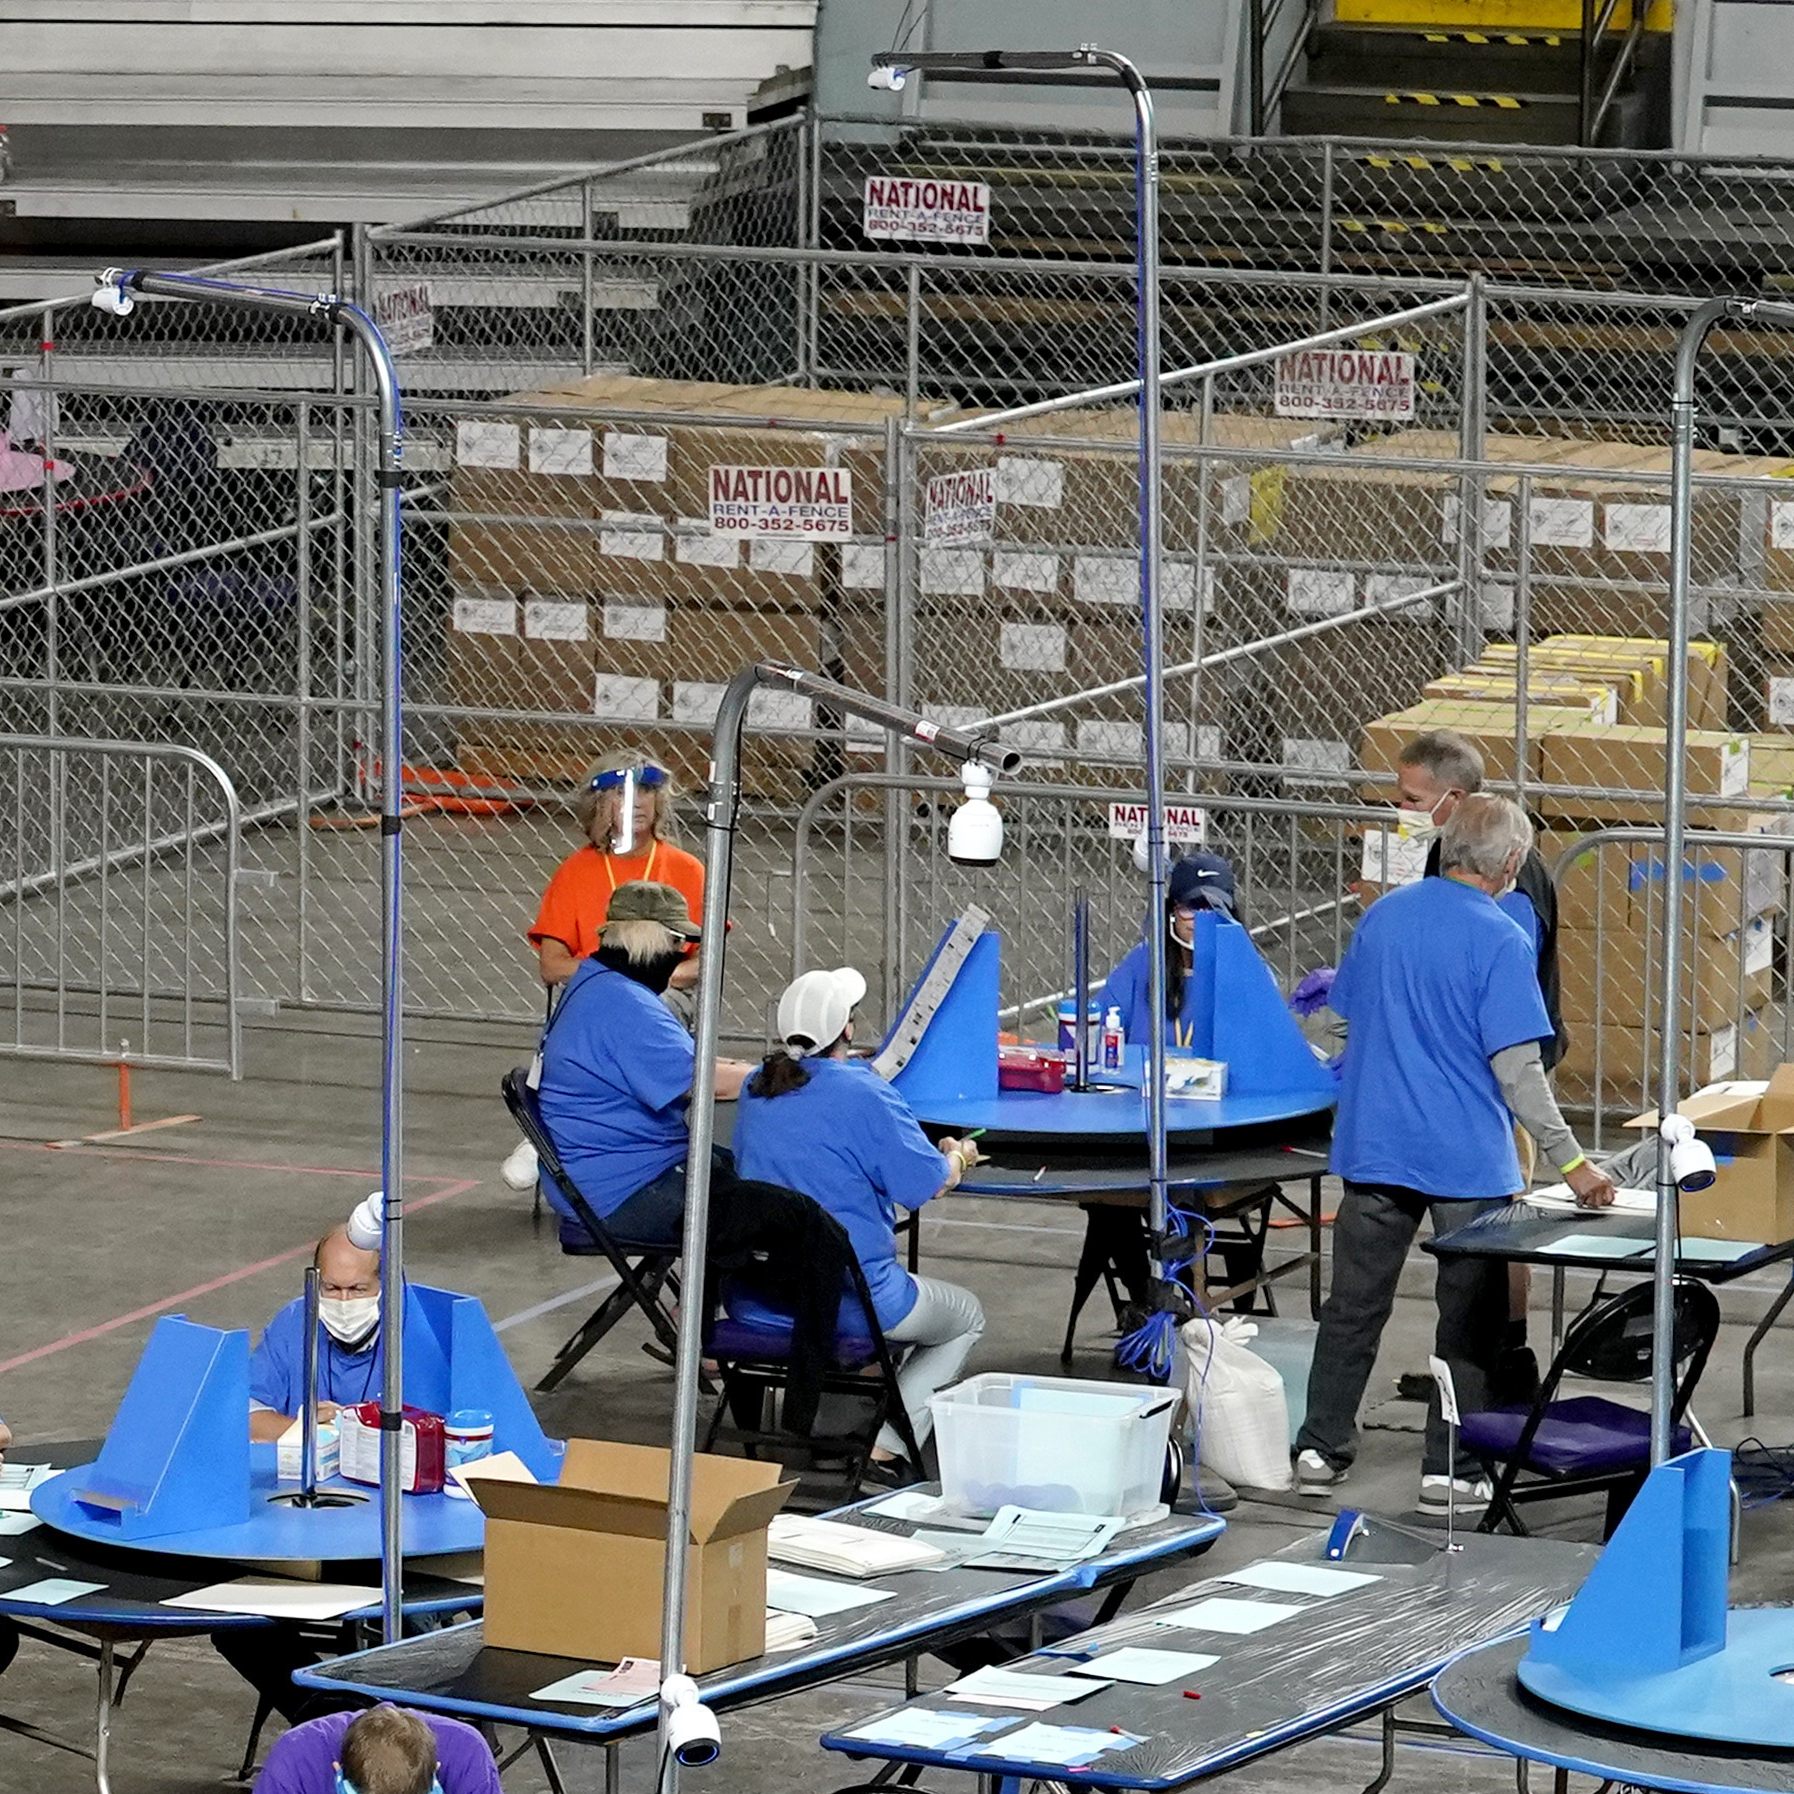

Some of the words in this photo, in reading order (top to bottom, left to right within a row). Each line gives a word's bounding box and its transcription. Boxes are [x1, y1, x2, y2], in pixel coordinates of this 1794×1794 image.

[869, 180, 984, 213] NATIONAL
[868, 209, 984, 224] RENT-A-FENCE
[1279, 352, 1410, 386] NATIONAL
[714, 469, 849, 504] NATIONAL
[714, 504, 849, 518] RENT-A-FENCE
[714, 517, 849, 532] 800-352-5675
[1115, 805, 1200, 827] NATNAL
